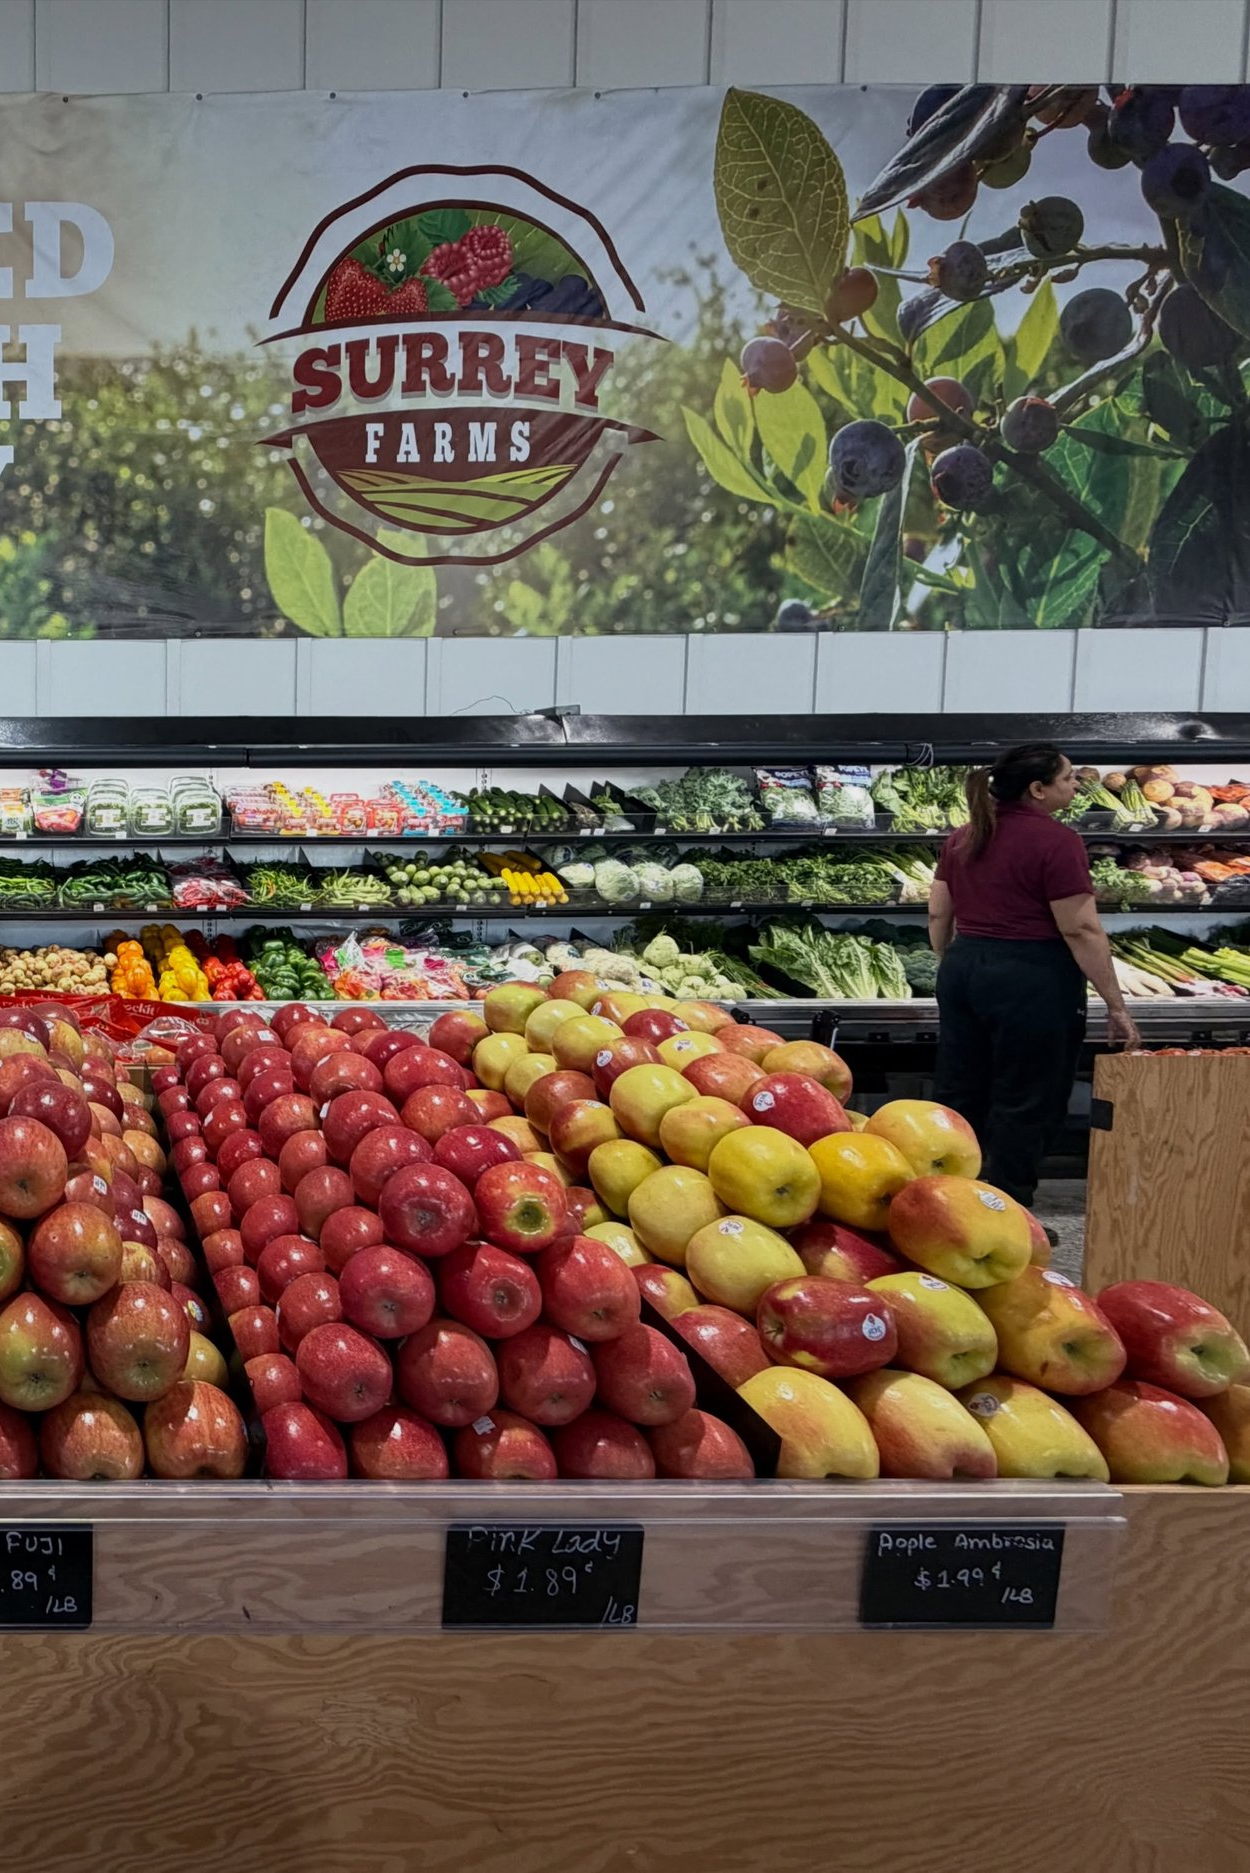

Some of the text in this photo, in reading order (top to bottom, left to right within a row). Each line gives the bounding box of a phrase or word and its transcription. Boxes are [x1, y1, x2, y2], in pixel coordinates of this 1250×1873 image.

[291, 331, 614, 414] SURREY
[365, 421, 531, 463] FARMS
[6, 1531, 63, 1556] FUJI
[878, 1533, 1055, 1557] Apple Ambrosia
